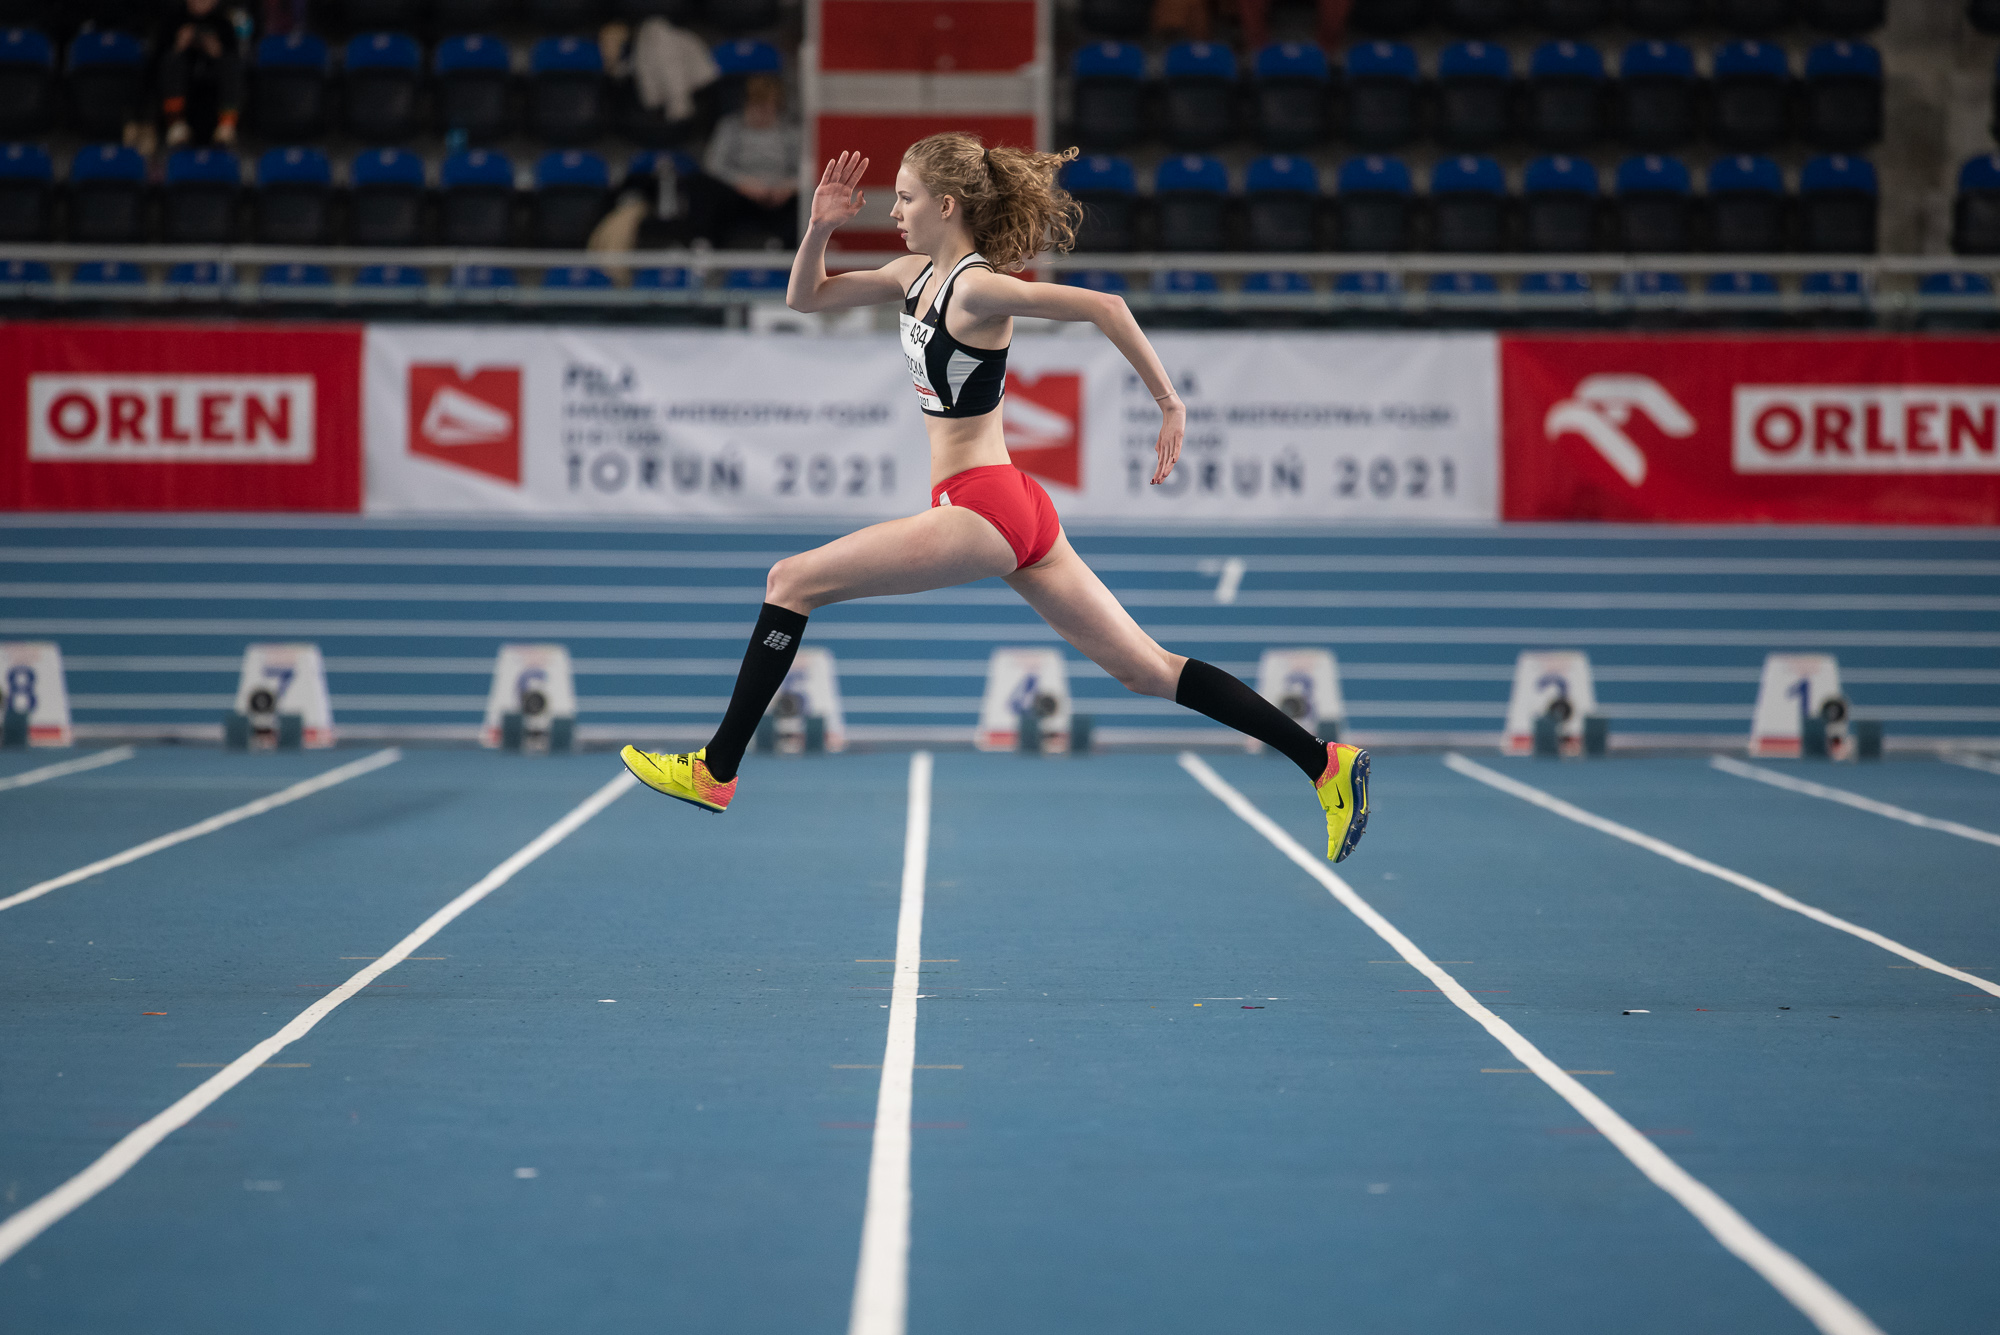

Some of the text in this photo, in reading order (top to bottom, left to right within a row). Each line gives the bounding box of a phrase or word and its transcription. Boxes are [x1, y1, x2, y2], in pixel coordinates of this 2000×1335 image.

[910, 322, 929, 349] 434
[46, 389, 292, 445] ORLEN
[1751, 403, 1997, 457] ORLEN
[775, 456, 895, 494] 2021
[1337, 458, 1457, 496] 2021
[8, 665, 37, 714] 8
[264, 667, 296, 704] 7
[1786, 678, 1812, 717] 1
